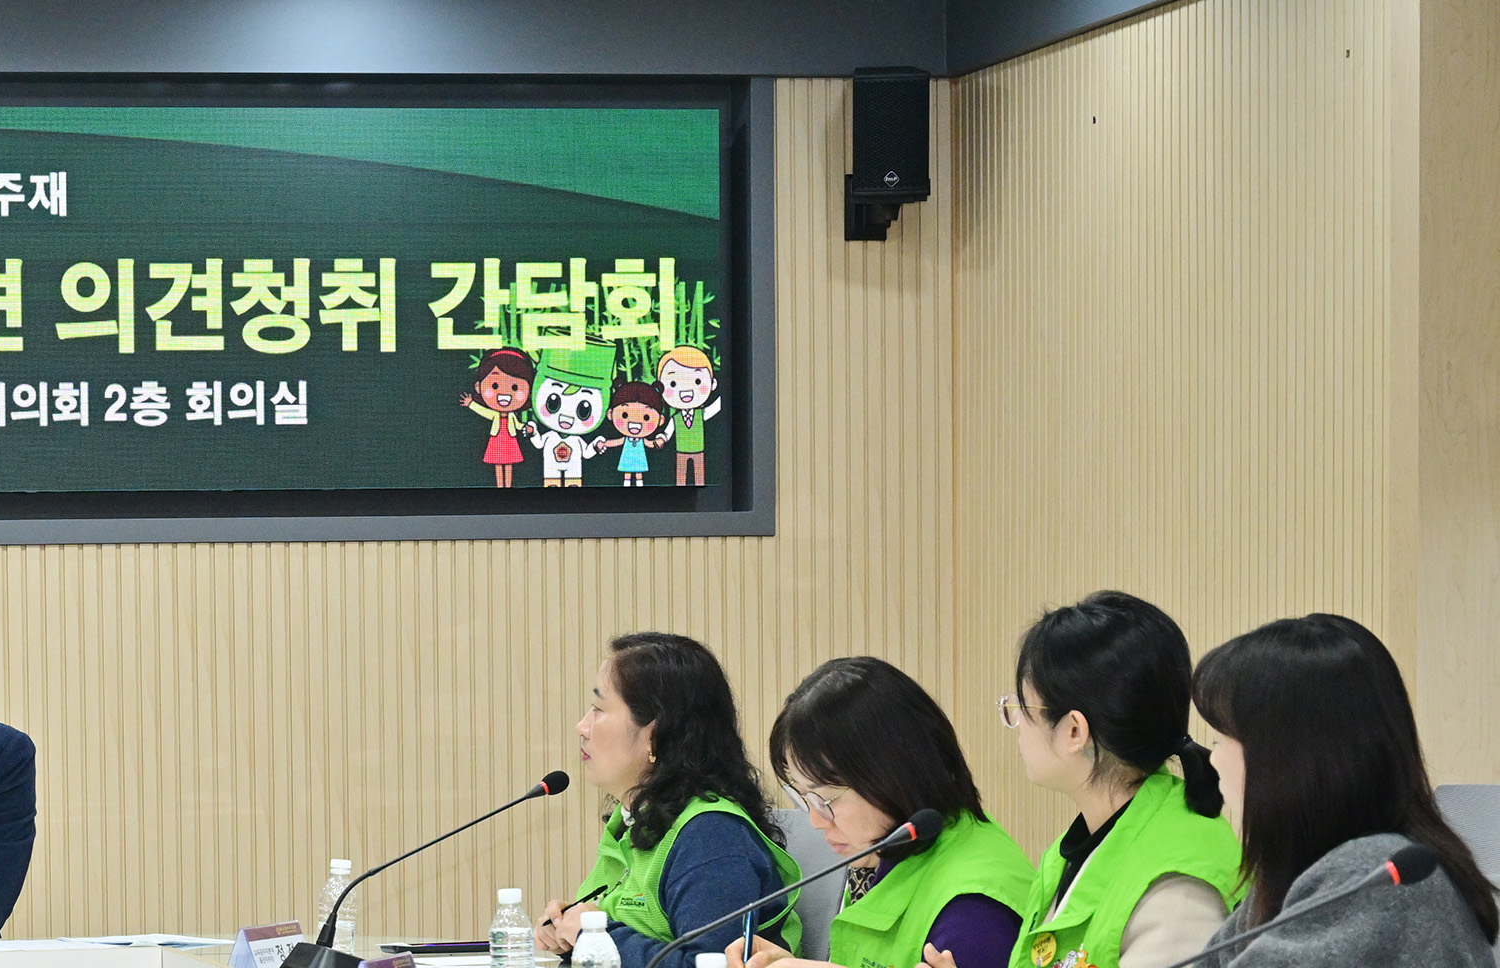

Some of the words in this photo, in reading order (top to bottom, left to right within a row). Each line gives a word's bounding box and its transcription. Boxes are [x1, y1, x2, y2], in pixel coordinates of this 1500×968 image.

[55, 257, 398, 355] 의견청취
[428, 257, 676, 353] 간담회
[104, 381, 173, 428] 2층
[186, 380, 310, 428] 회의실
